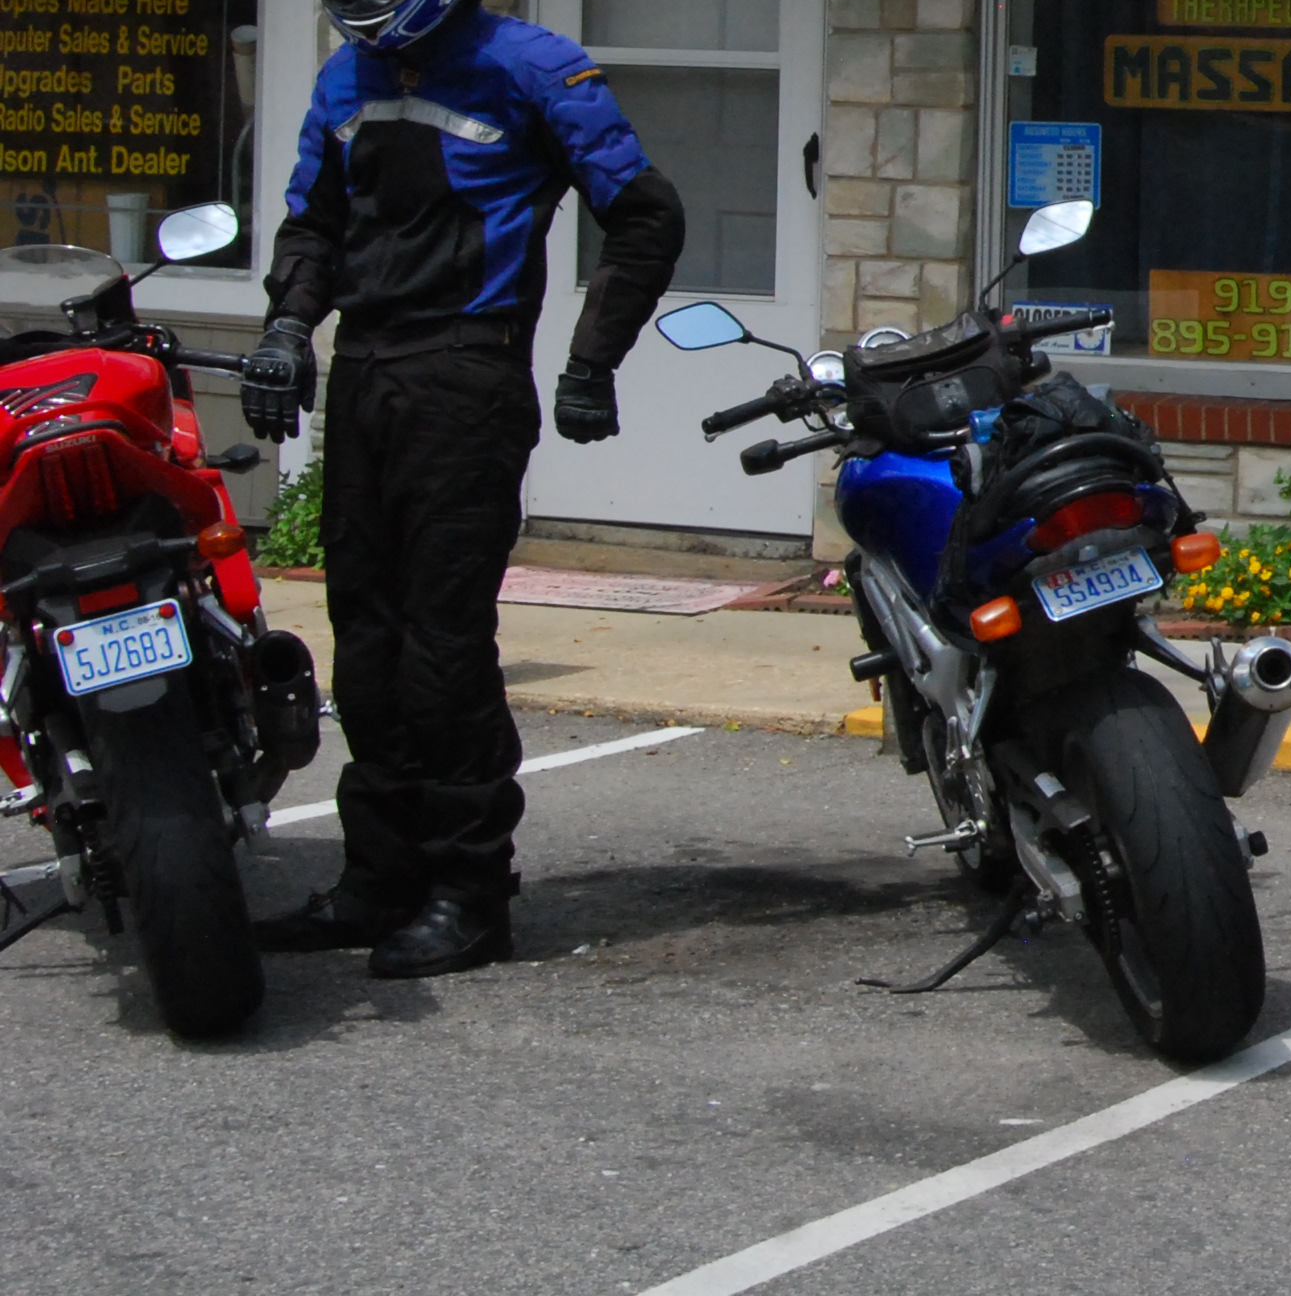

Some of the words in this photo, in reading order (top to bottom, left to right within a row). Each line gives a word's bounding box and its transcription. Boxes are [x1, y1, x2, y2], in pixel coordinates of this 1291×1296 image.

[59, 24, 110, 54] Sales
[117, 25, 129, 54] &
[137, 25, 208, 56] Service
[117, 65, 175, 95] Parts
[51, 103, 102, 133] Sales
[109, 104, 123, 134] &
[130, 105, 200, 136] Service
[55, 144, 103, 173] Ant.
[111, 145, 190, 175] Dealer
[46, 435, 96, 453] SUZUKI
[76, 627, 173, 680] 5J2683
